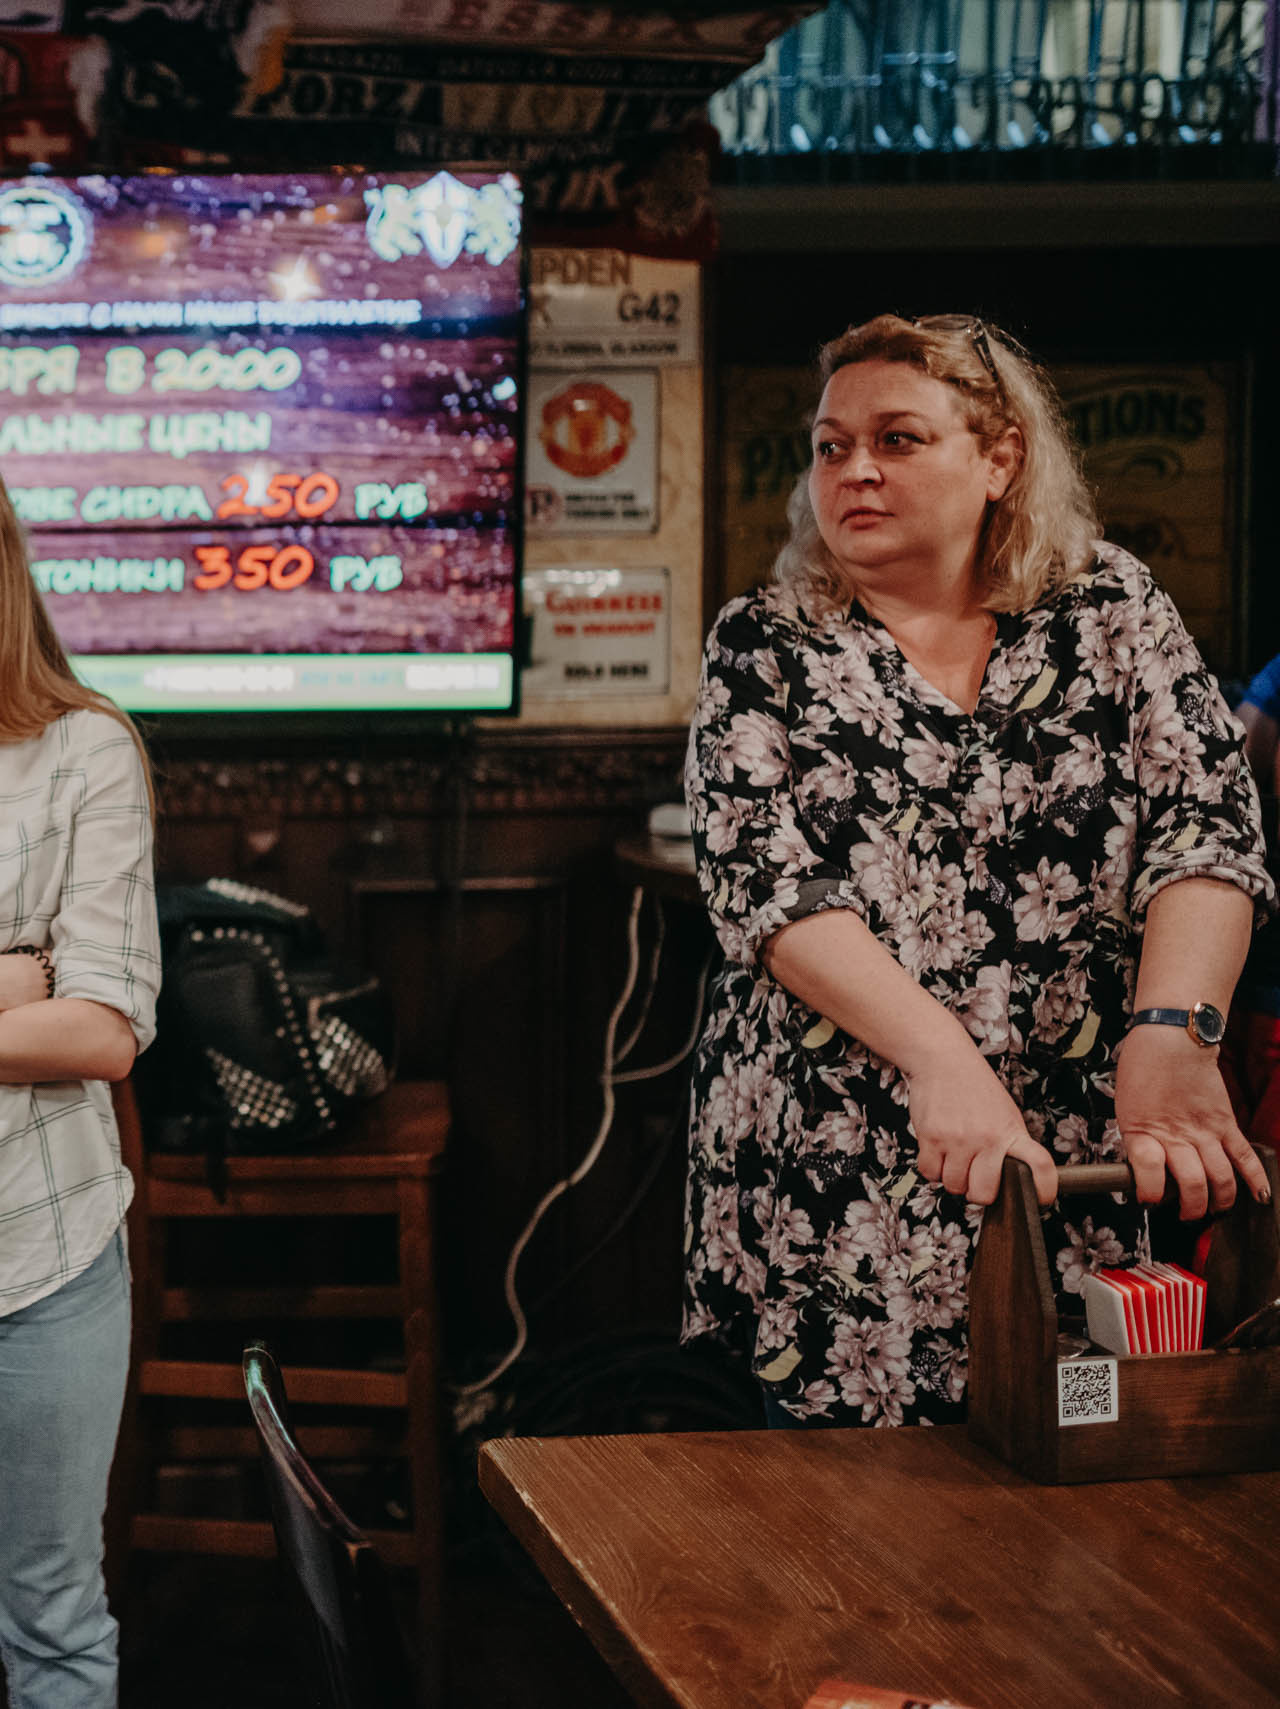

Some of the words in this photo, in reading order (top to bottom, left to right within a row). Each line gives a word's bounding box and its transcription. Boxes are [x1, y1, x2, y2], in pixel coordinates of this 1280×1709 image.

[618, 292, 681, 326] G42
[151, 346, 303, 391] 20:00
[148, 410, 274, 459] ЦЕНЫ
[80, 485, 214, 524] СИДРА
[217, 472, 340, 521] 250
[354, 482, 429, 519] РУБ
[193, 544, 314, 592] 350
[329, 555, 404, 593] РУБ
